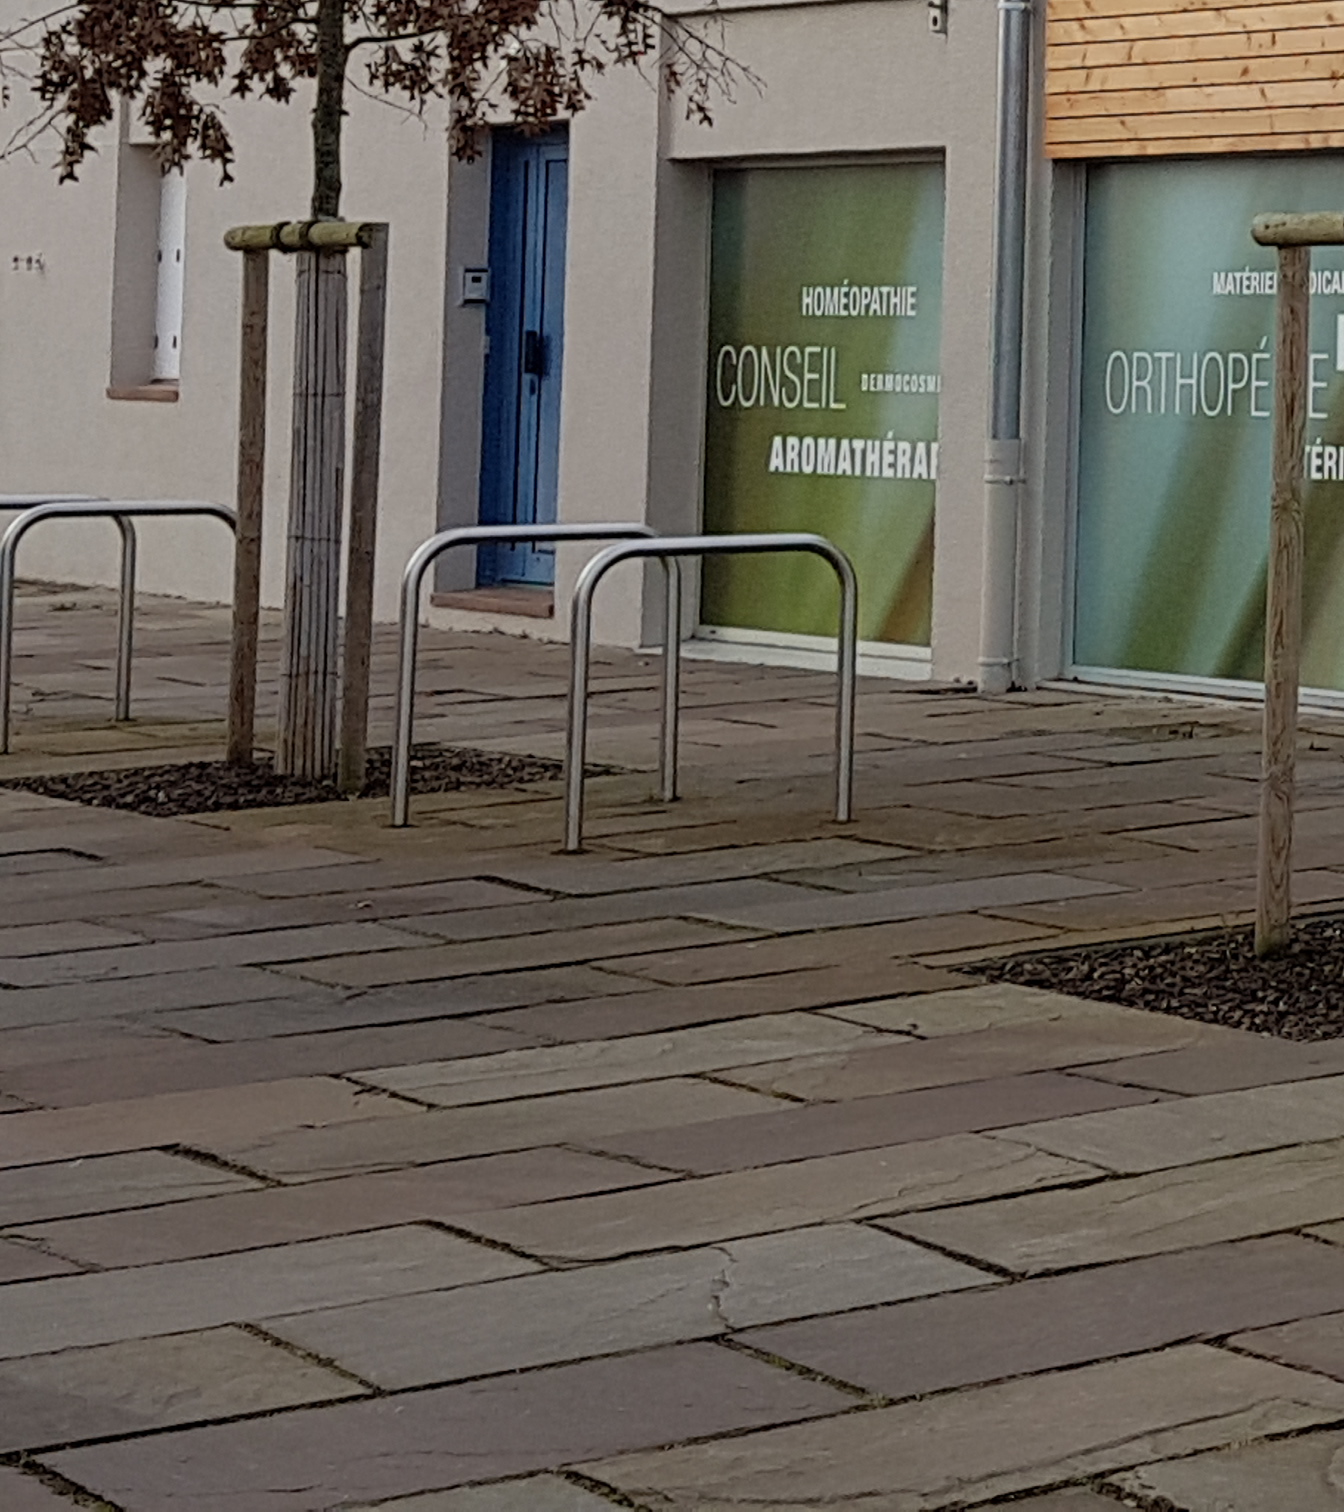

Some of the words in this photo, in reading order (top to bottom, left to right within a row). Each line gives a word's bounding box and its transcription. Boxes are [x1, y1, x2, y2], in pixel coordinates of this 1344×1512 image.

[802, 279, 917, 317] HOMÉOPATHIE
[1213, 266, 1277, 295] MATÉRIE
[716, 345, 847, 409] CONSEIL
[861, 373, 940, 393] DERMOCOSM
[1105, 336, 1329, 419] ORTHOPÉE
